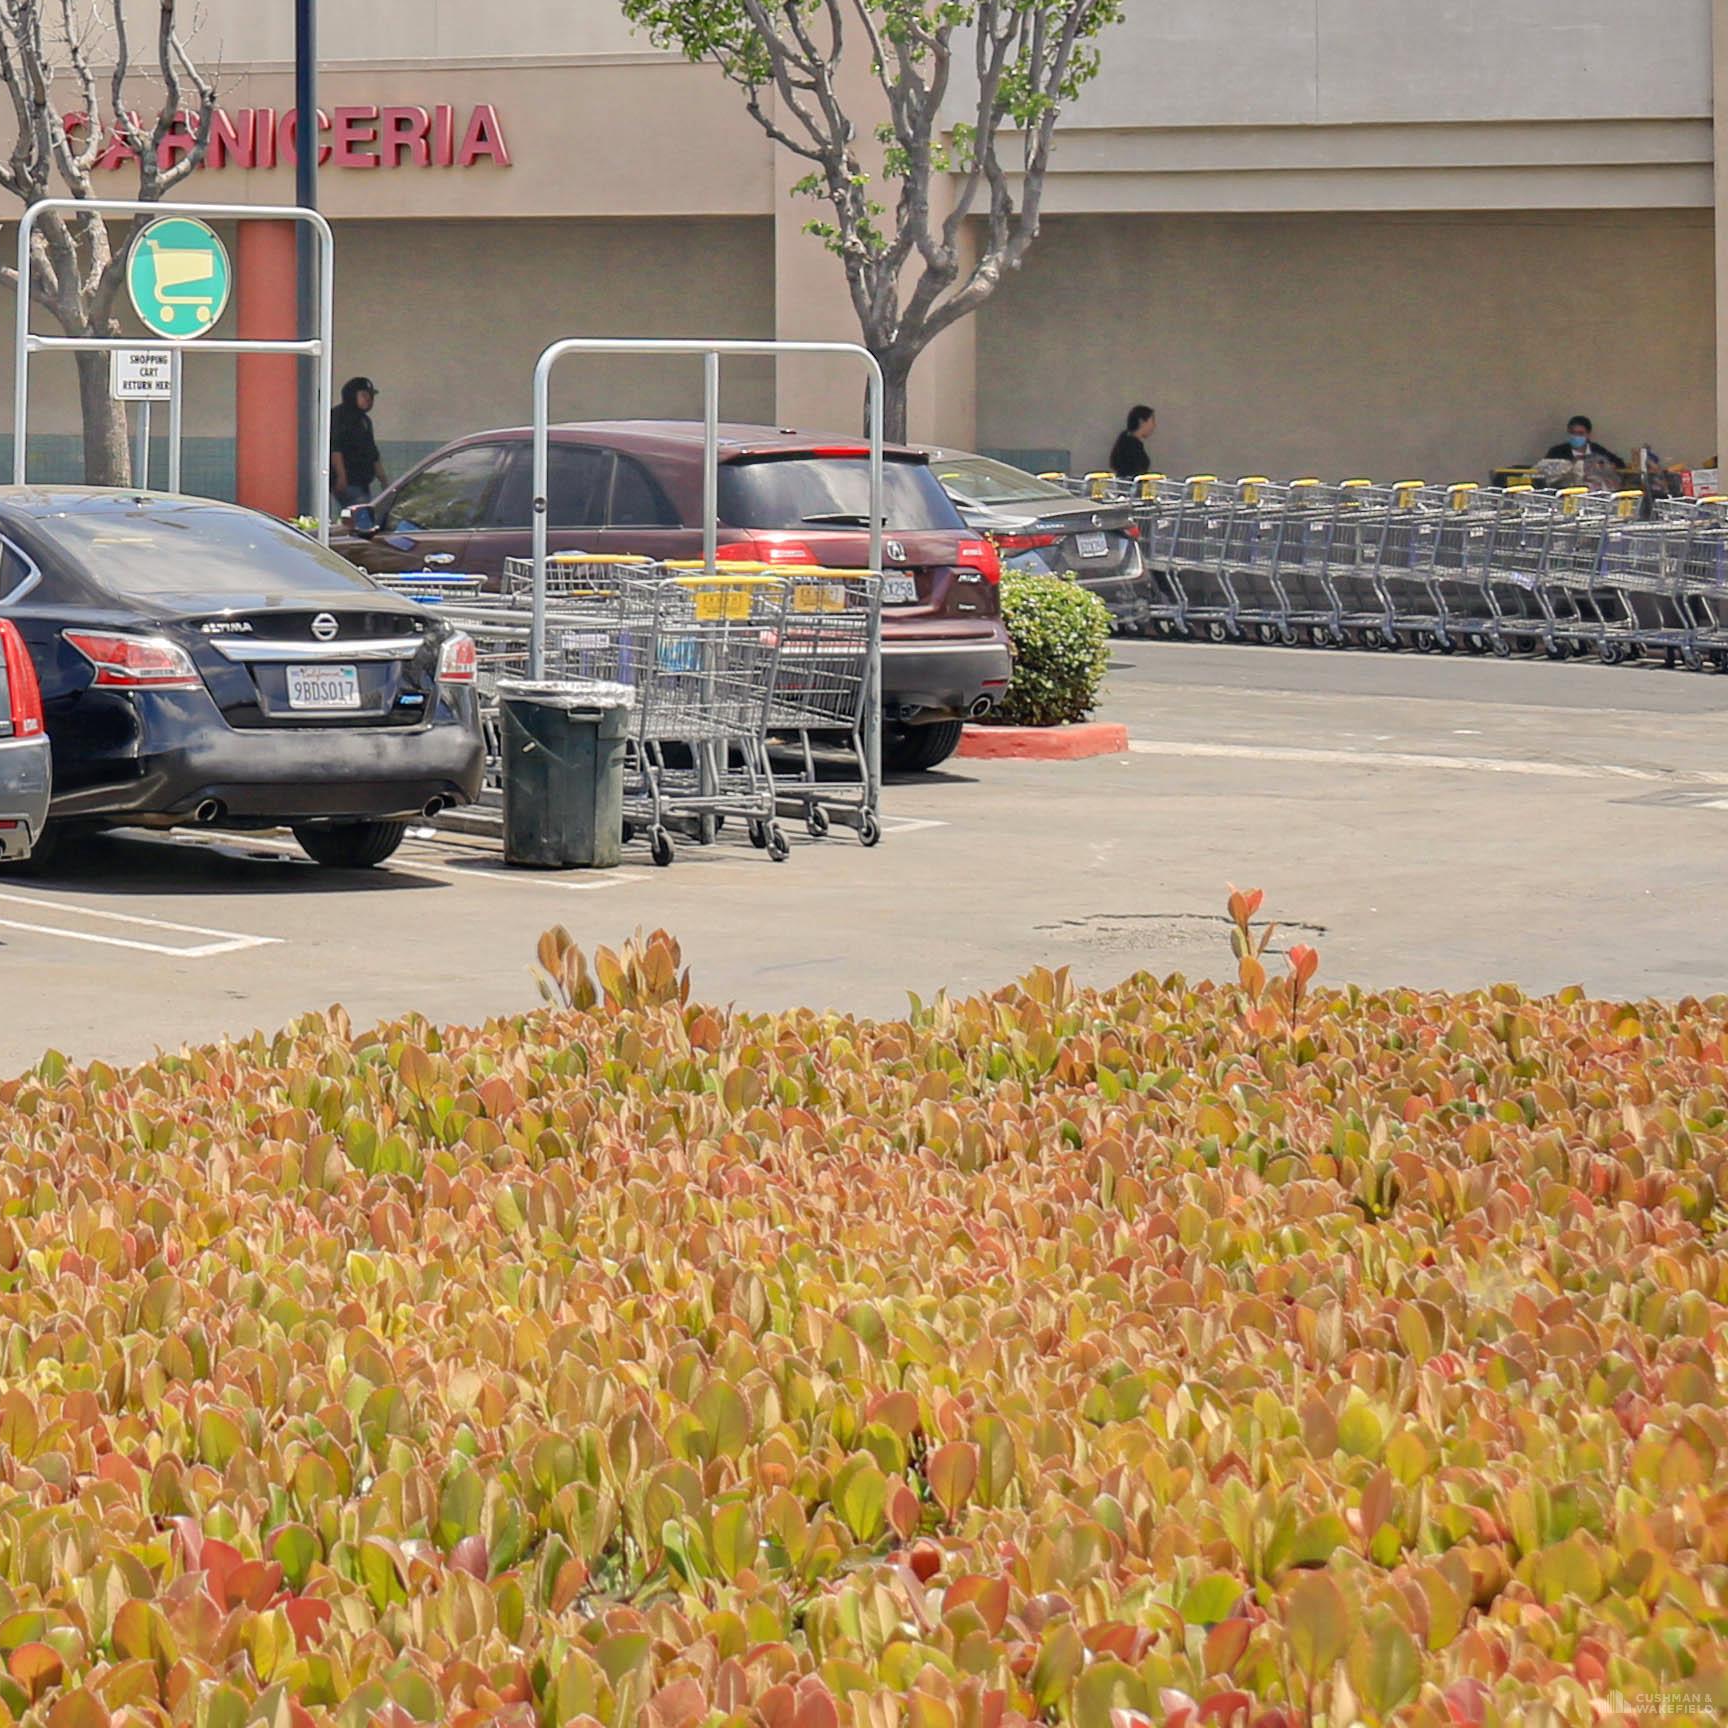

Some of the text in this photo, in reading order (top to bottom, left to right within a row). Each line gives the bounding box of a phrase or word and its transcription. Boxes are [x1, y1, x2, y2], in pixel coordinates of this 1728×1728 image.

[62, 103, 512, 170] CARNICERIA
[130, 355, 168, 364] SHOPPING
[139, 367, 159, 377] CART
[123, 381, 152, 390] RETURN
[200, 621, 254, 633] ALTIMA
[294, 680, 355, 702] 9BDS017
